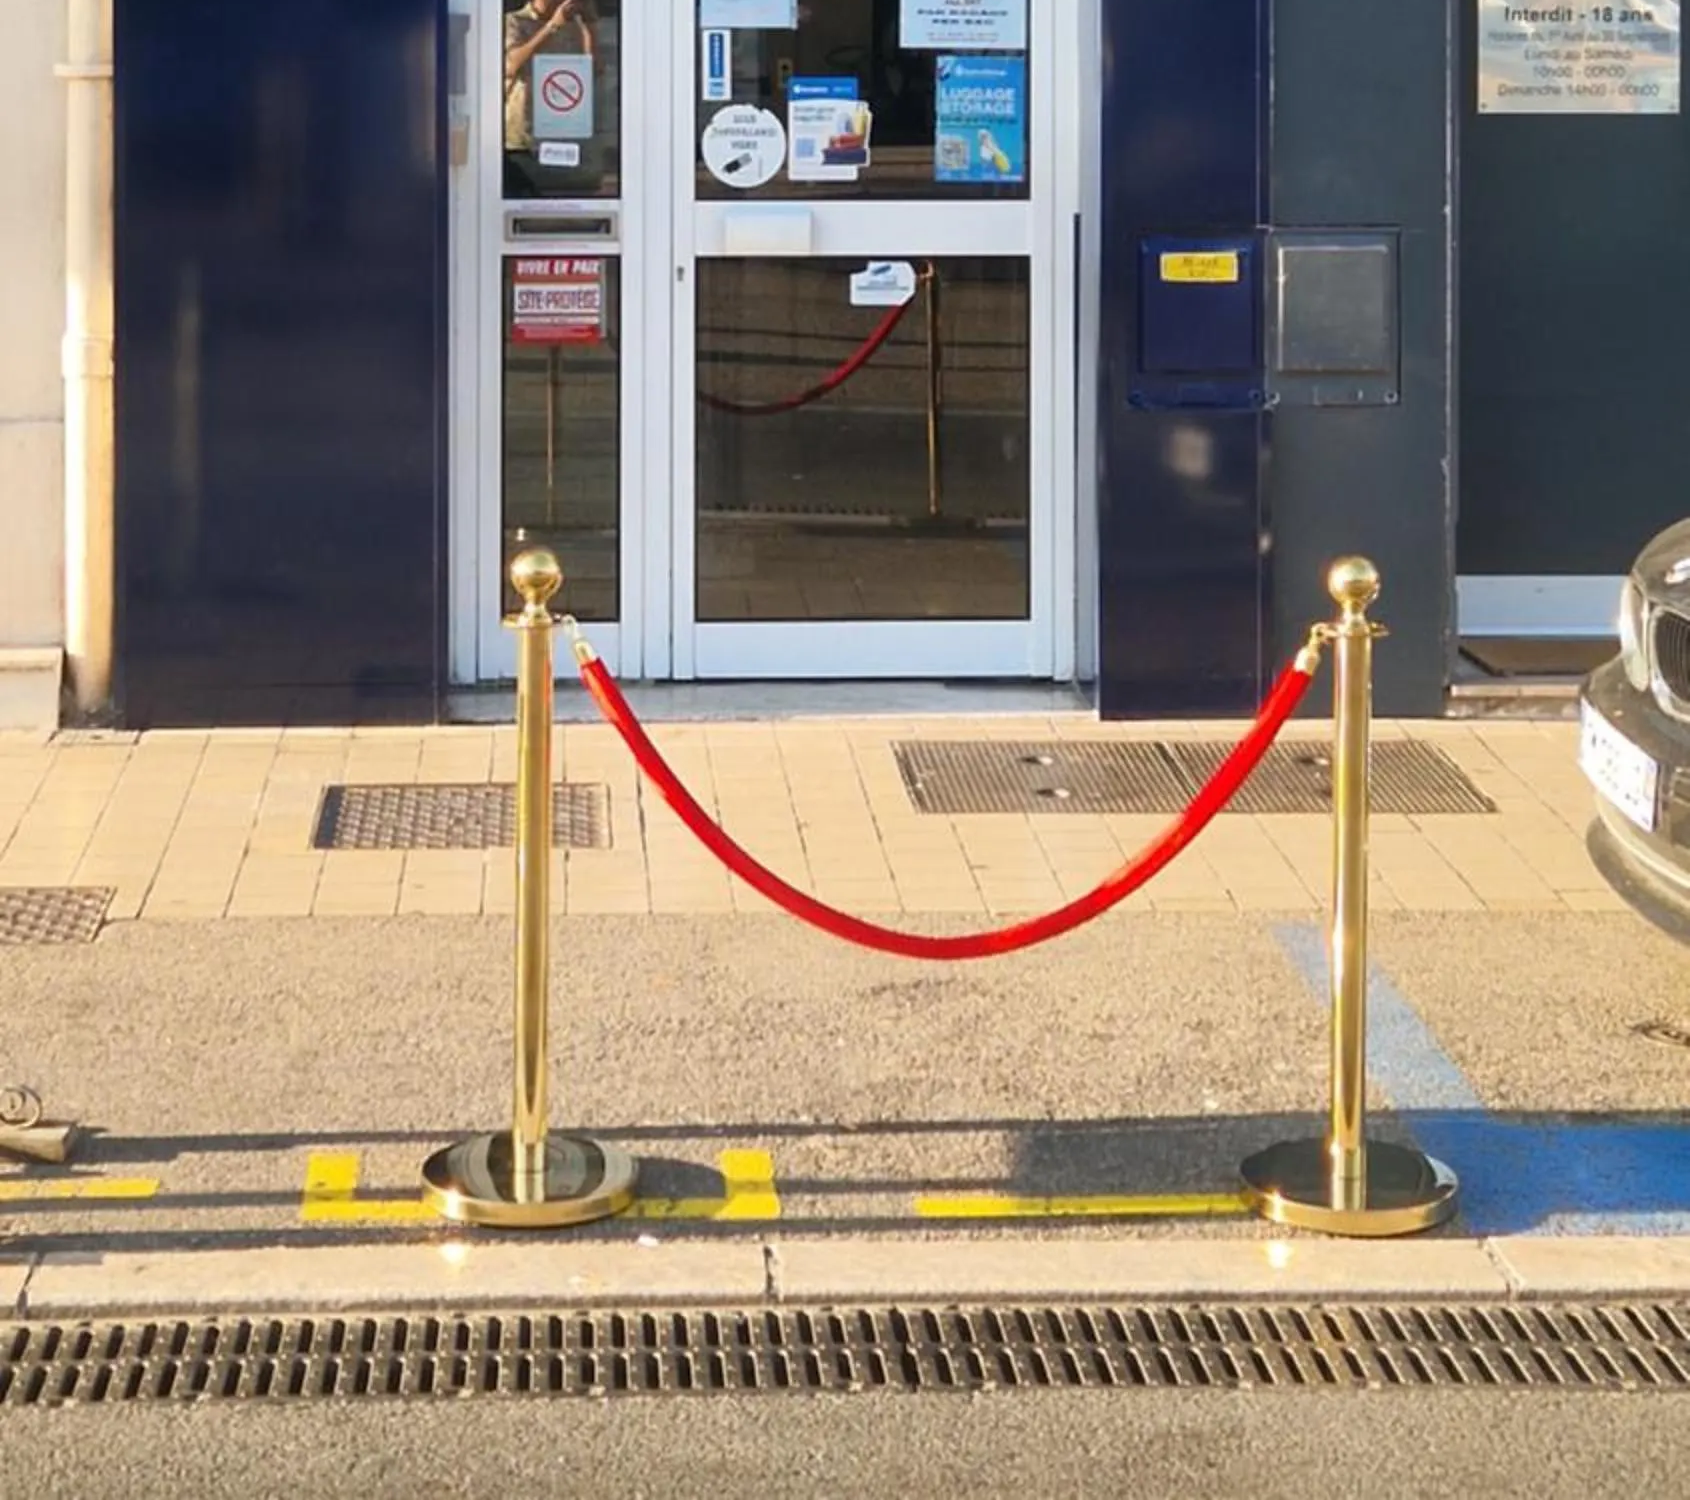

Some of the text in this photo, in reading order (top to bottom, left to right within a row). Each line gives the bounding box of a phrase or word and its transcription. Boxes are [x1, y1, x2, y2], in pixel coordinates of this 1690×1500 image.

[1504, 6, 1573, 23] Interdit
[1592, 6, 1614, 23] 18
[1618, 8, 1654, 23] ans
[941, 87, 1015, 99] LUGGAGE
[1497, 83, 1561, 97] Dimanche
[940, 101, 1015, 115] STORAGE
[517, 259, 550, 274] VIVRE
